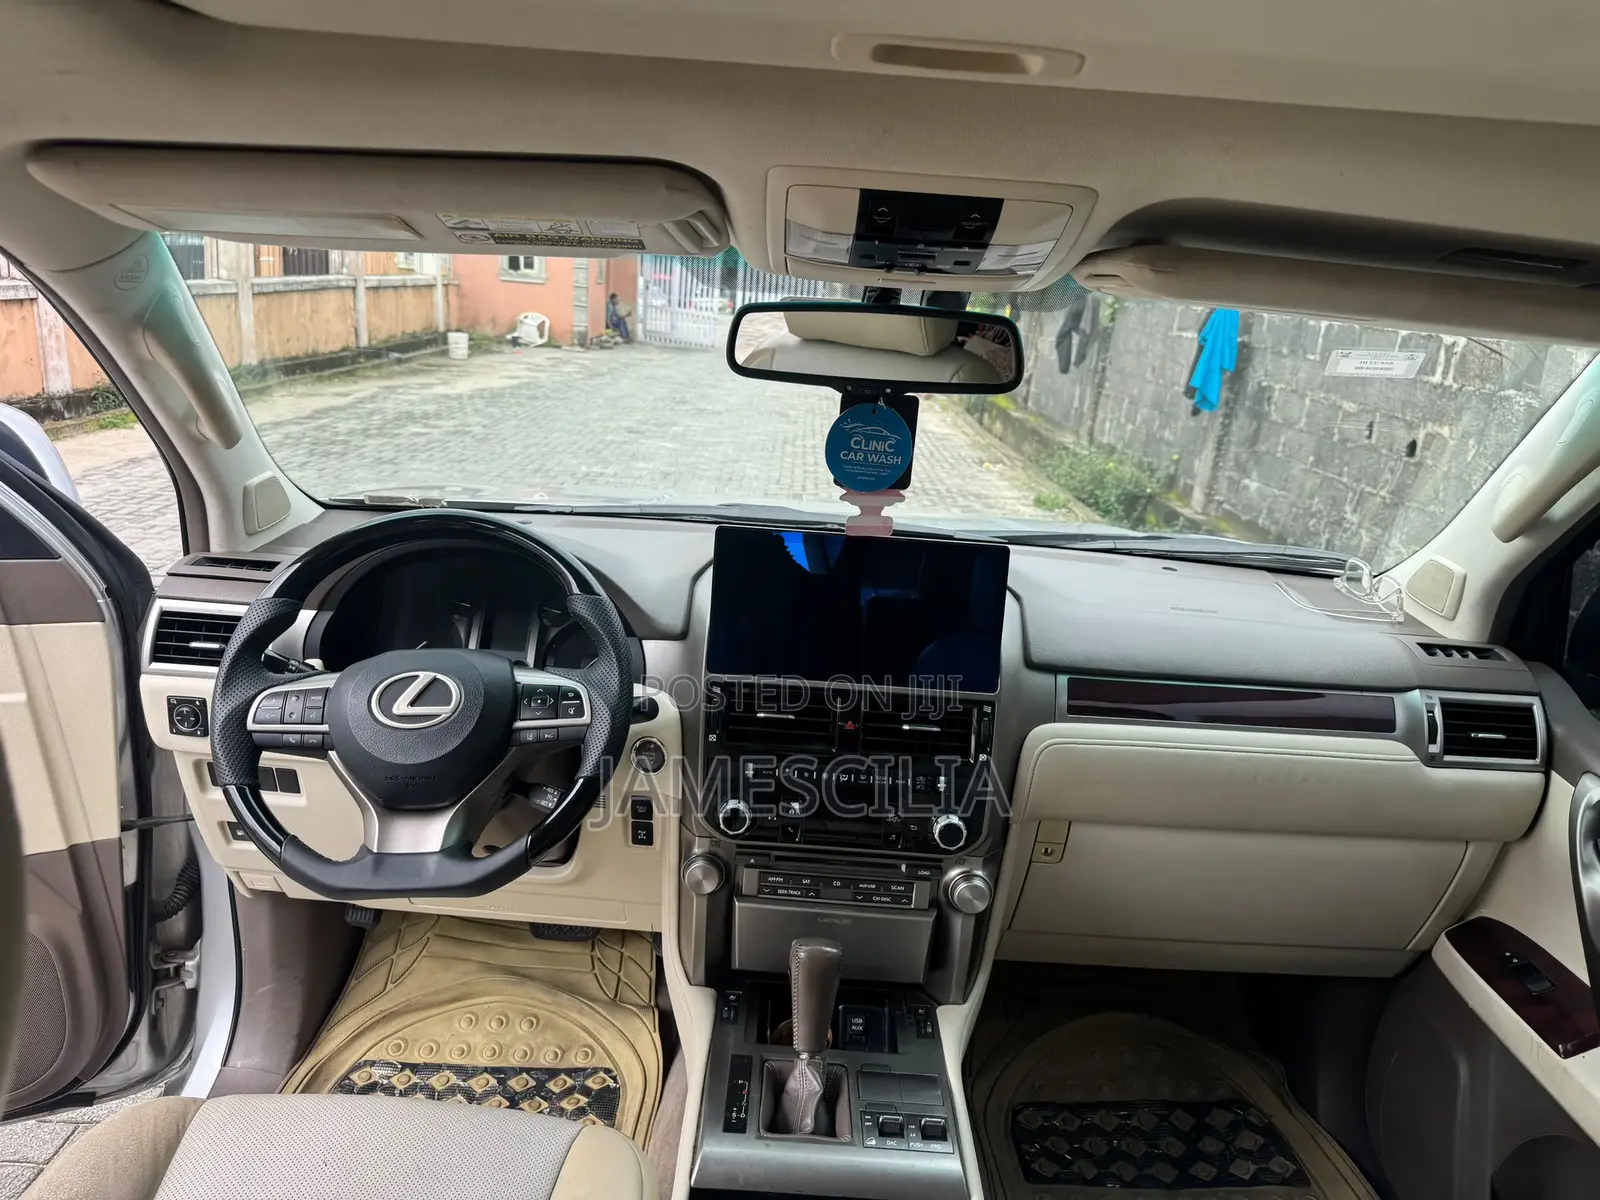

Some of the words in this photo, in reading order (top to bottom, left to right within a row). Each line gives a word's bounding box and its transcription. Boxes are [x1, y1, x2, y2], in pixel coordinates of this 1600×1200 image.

[840, 450, 865, 461] CAR
[867, 453, 902, 465] WASH
[909, 1141, 924, 1149] PUSH
